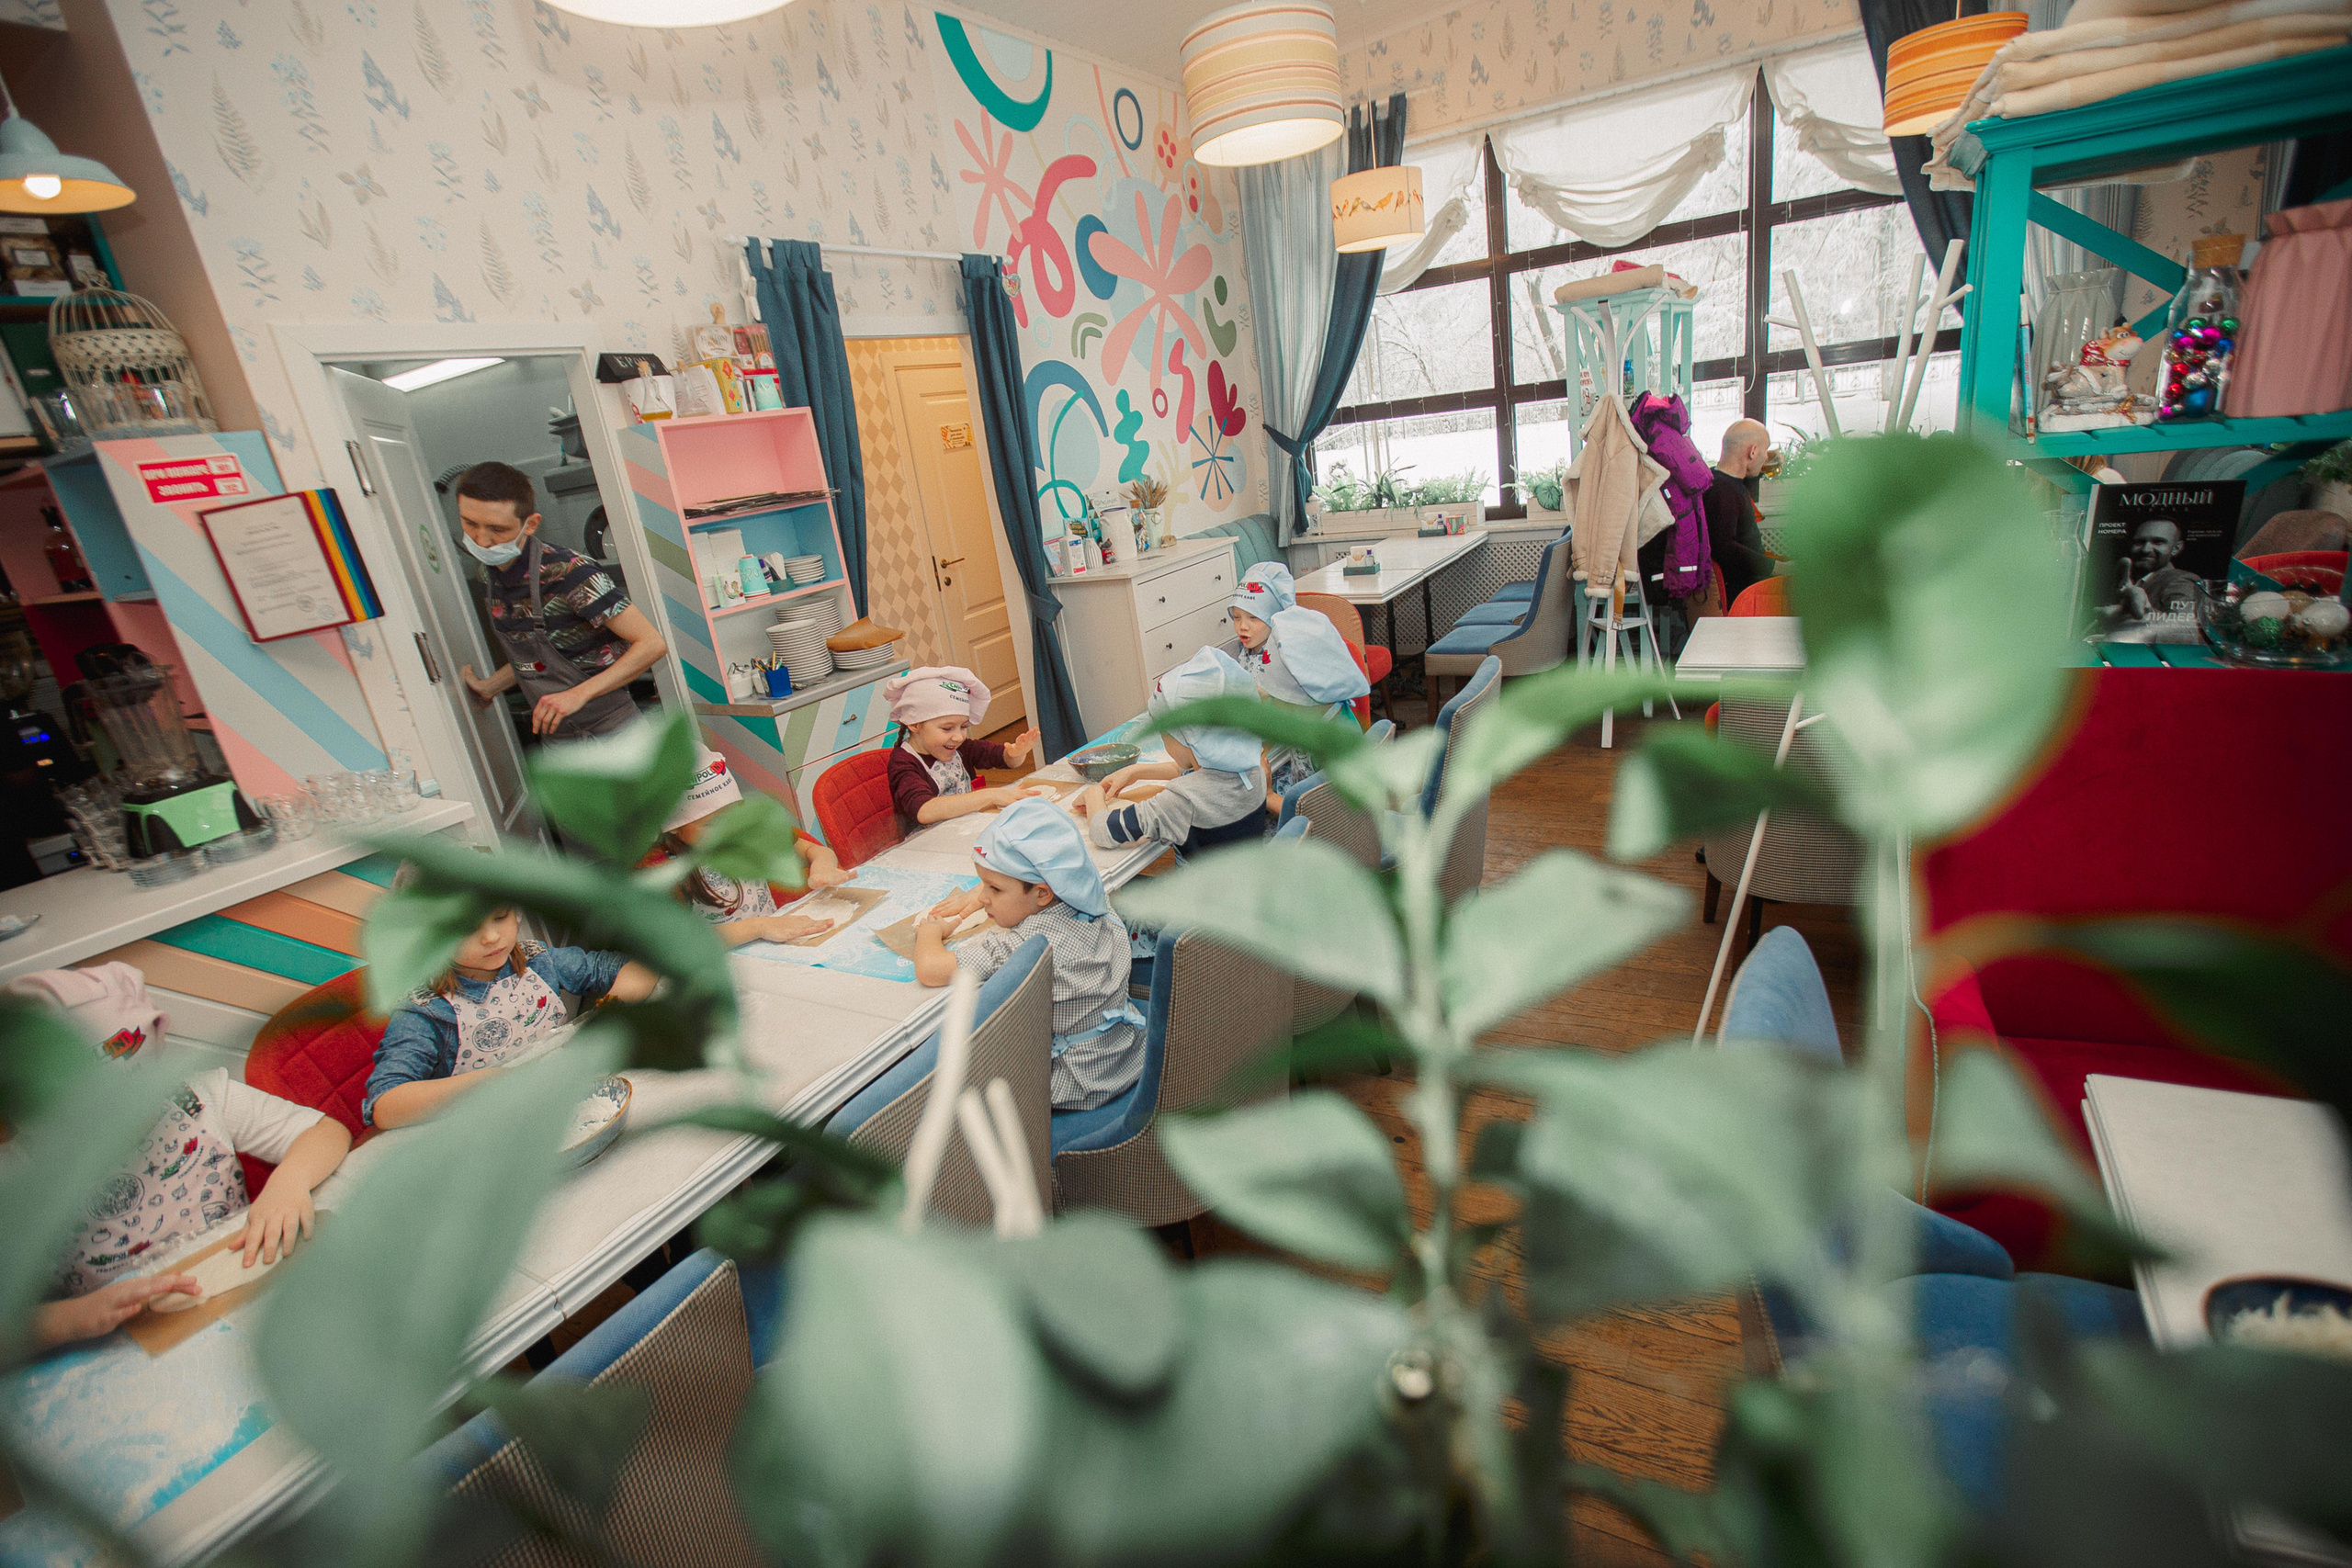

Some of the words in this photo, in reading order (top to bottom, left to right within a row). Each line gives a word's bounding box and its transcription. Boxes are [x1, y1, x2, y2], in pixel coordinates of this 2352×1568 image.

[2119, 489, 2214, 508] МОДНЫЙ
[2170, 600, 2196, 610] ПУТ
[2145, 612, 2196, 623] ЛИДЕР
[687, 784, 723, 801] СЕМЕЙНОЕ
